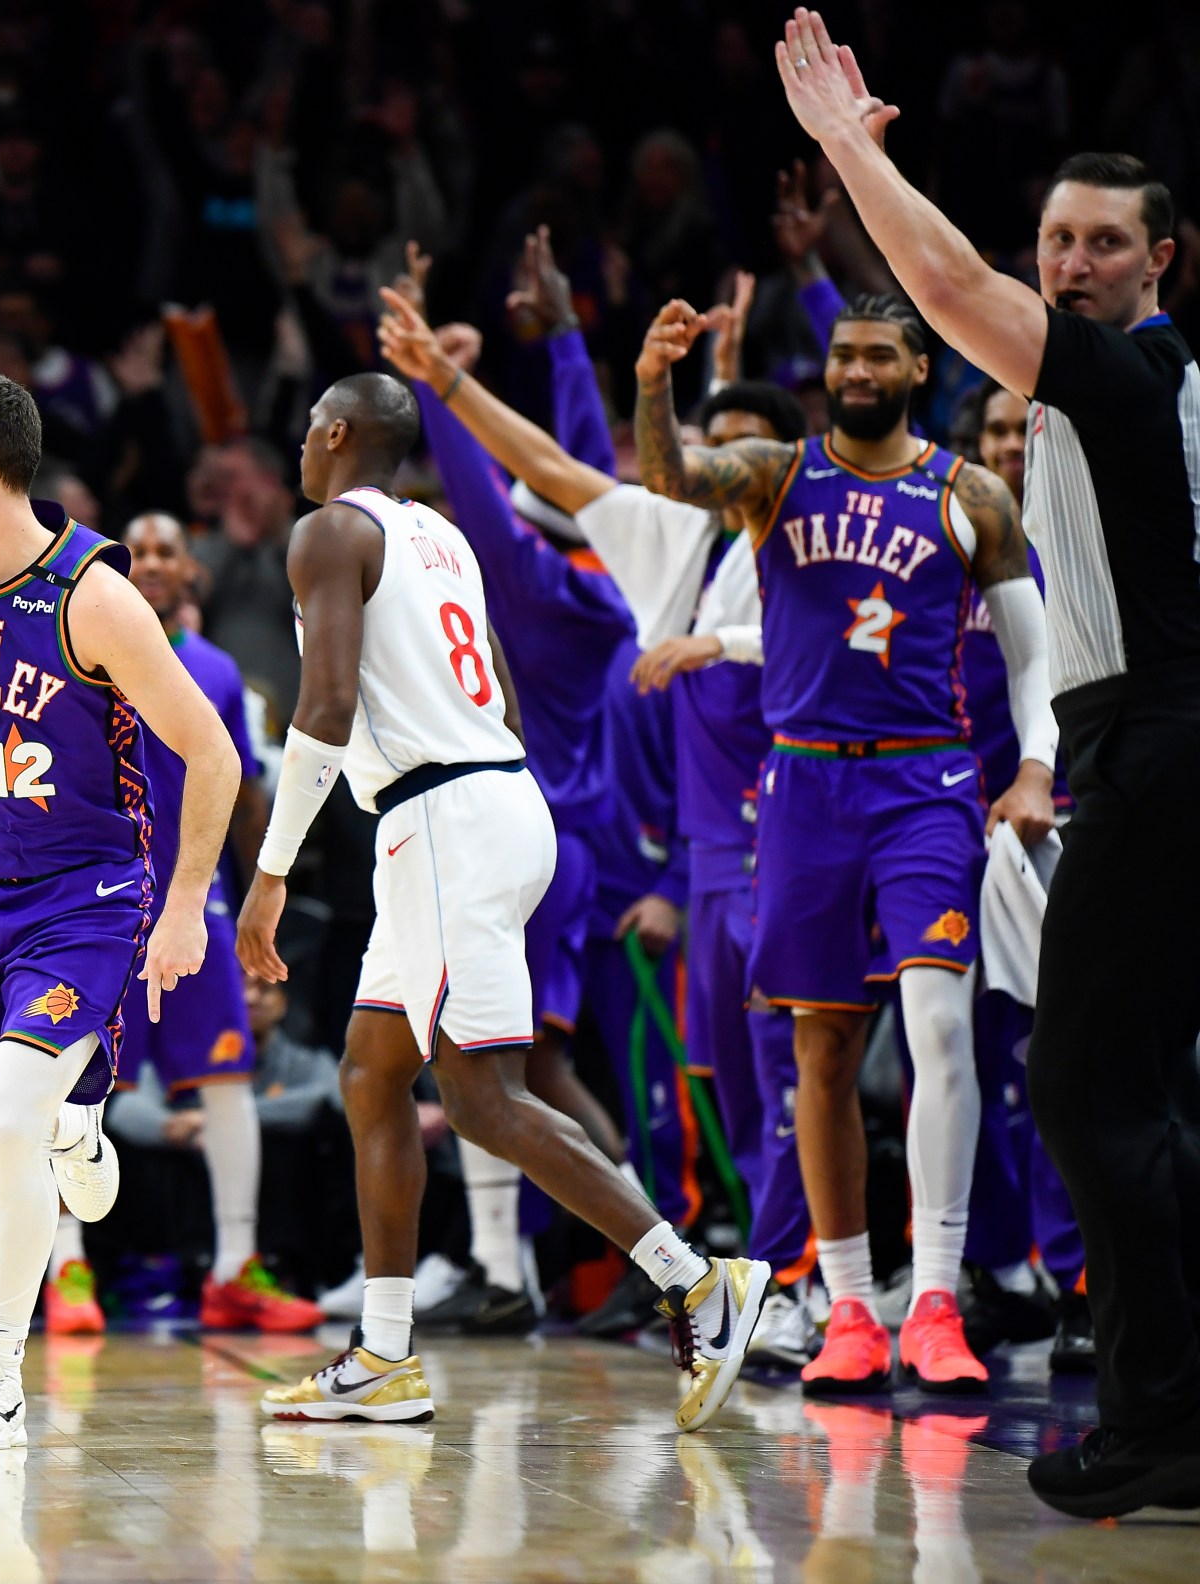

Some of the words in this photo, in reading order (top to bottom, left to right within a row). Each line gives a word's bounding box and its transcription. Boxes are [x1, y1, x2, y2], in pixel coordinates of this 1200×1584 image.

[847, 490, 884, 518] THE
[410, 535, 462, 578] DUNN
[784, 513, 938, 582] VALLEY
[46, 573, 55, 584] AL
[12, 595, 55, 614] PayPal
[849, 597, 893, 654] 2
[439, 602, 492, 707] 8
